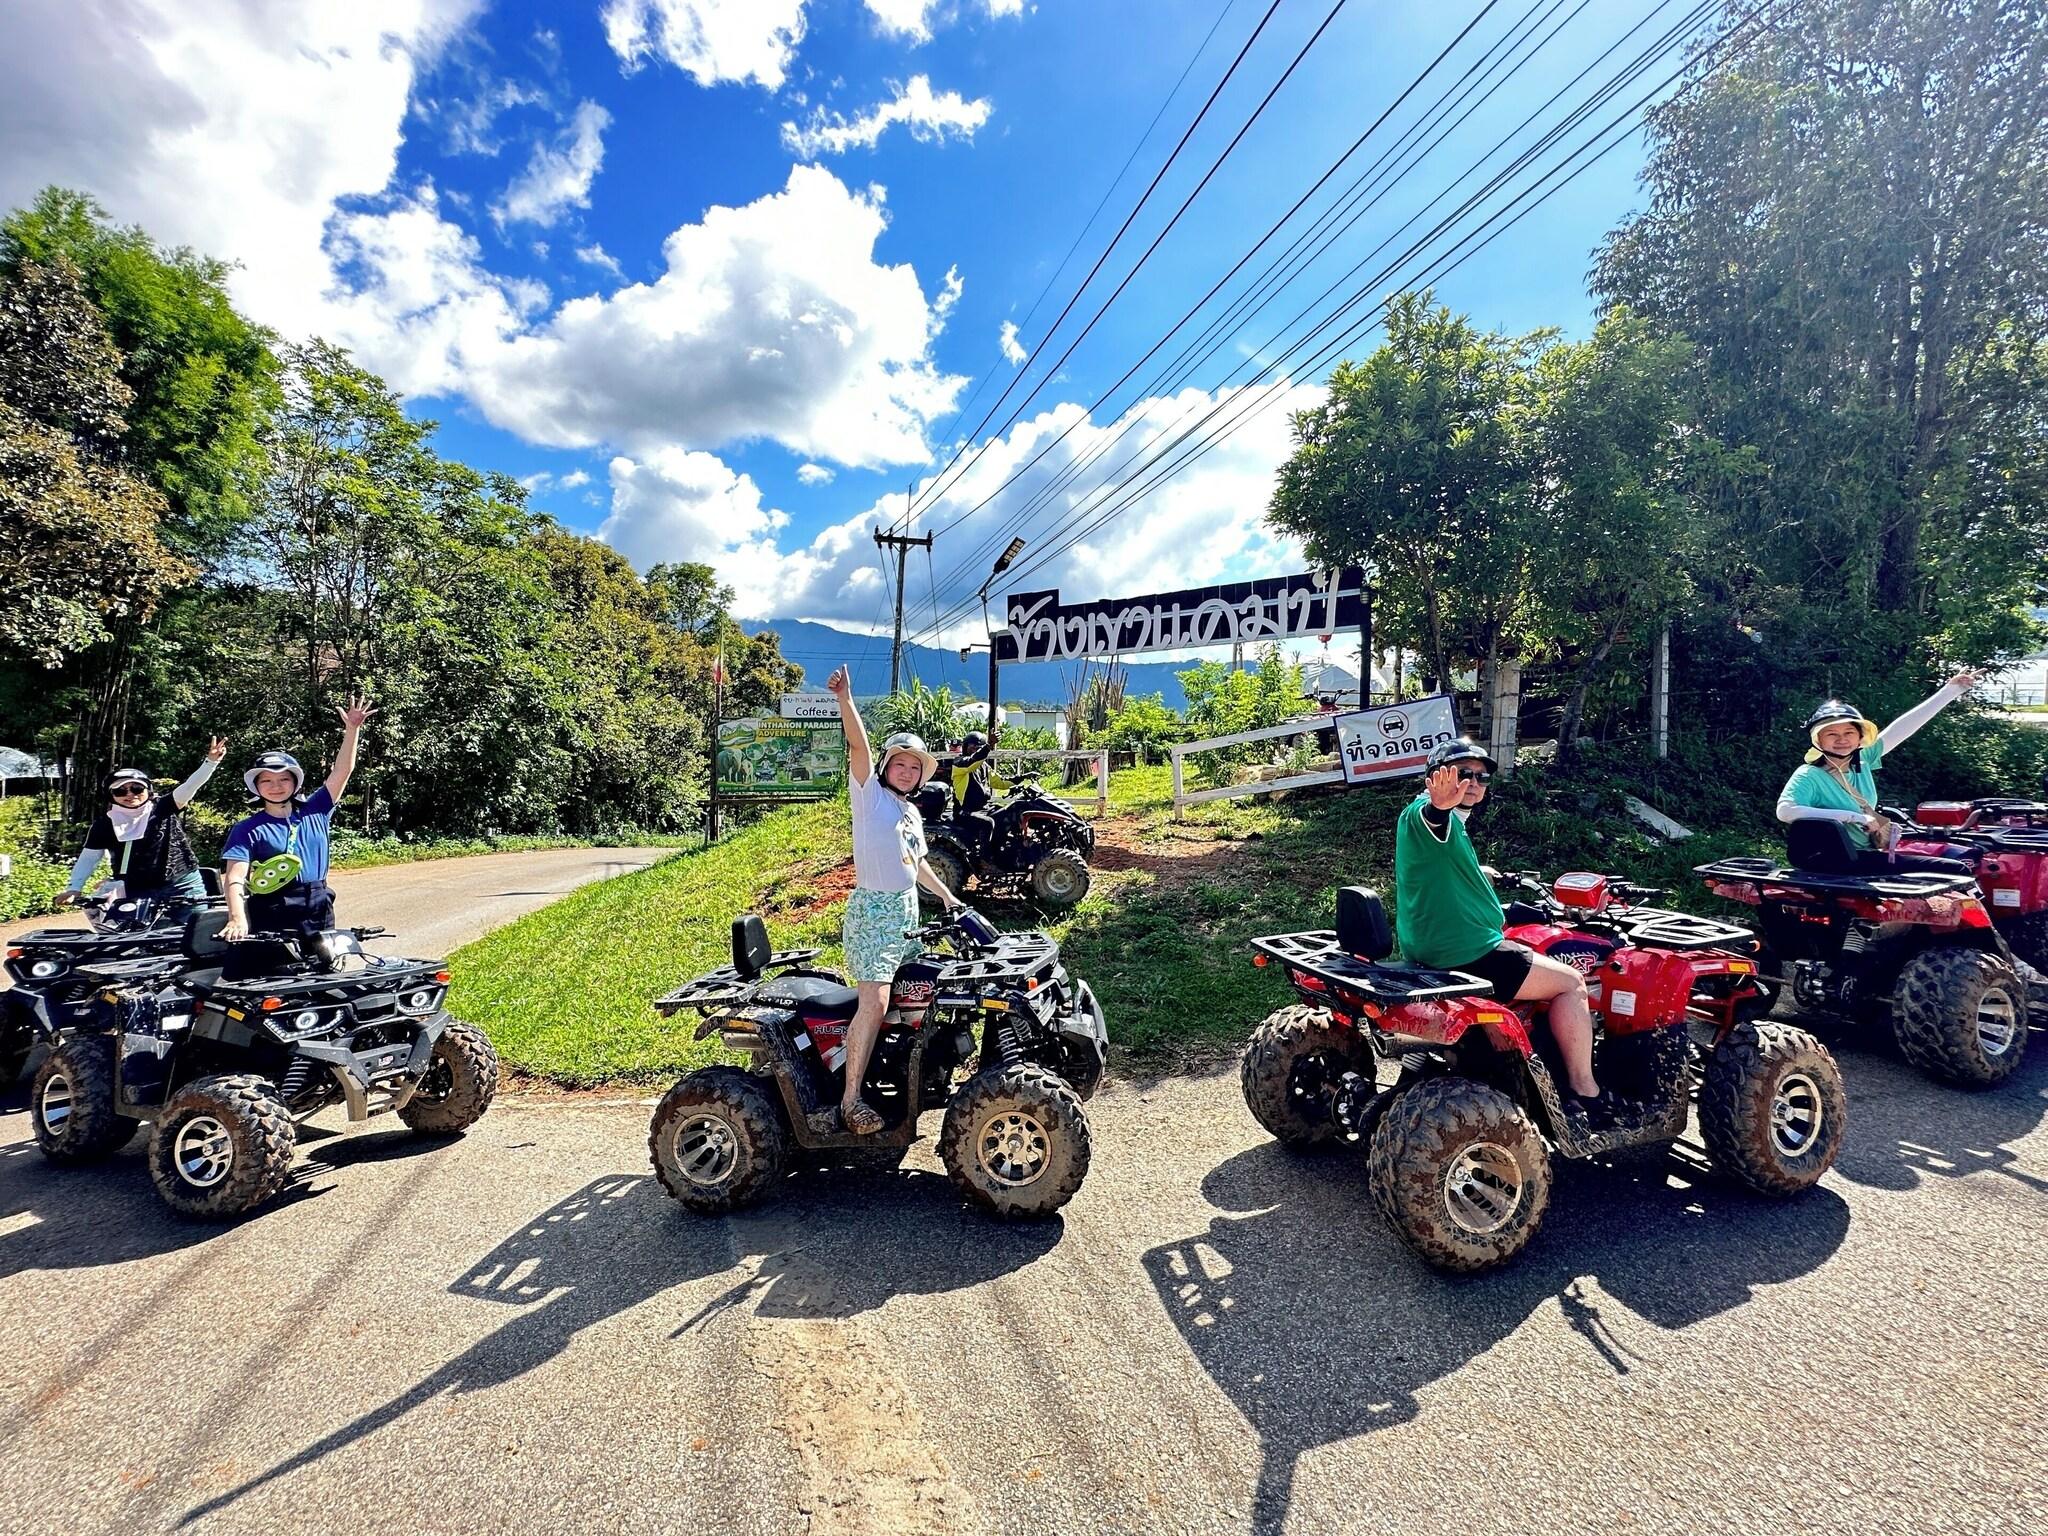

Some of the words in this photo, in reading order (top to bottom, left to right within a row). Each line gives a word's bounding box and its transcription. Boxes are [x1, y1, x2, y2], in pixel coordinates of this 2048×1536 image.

[795, 706, 828, 716] Coffee
[758, 721, 802, 730] INTHANON
[803, 721, 842, 729] PARADISE
[758, 730, 807, 738] ADVENTURE
